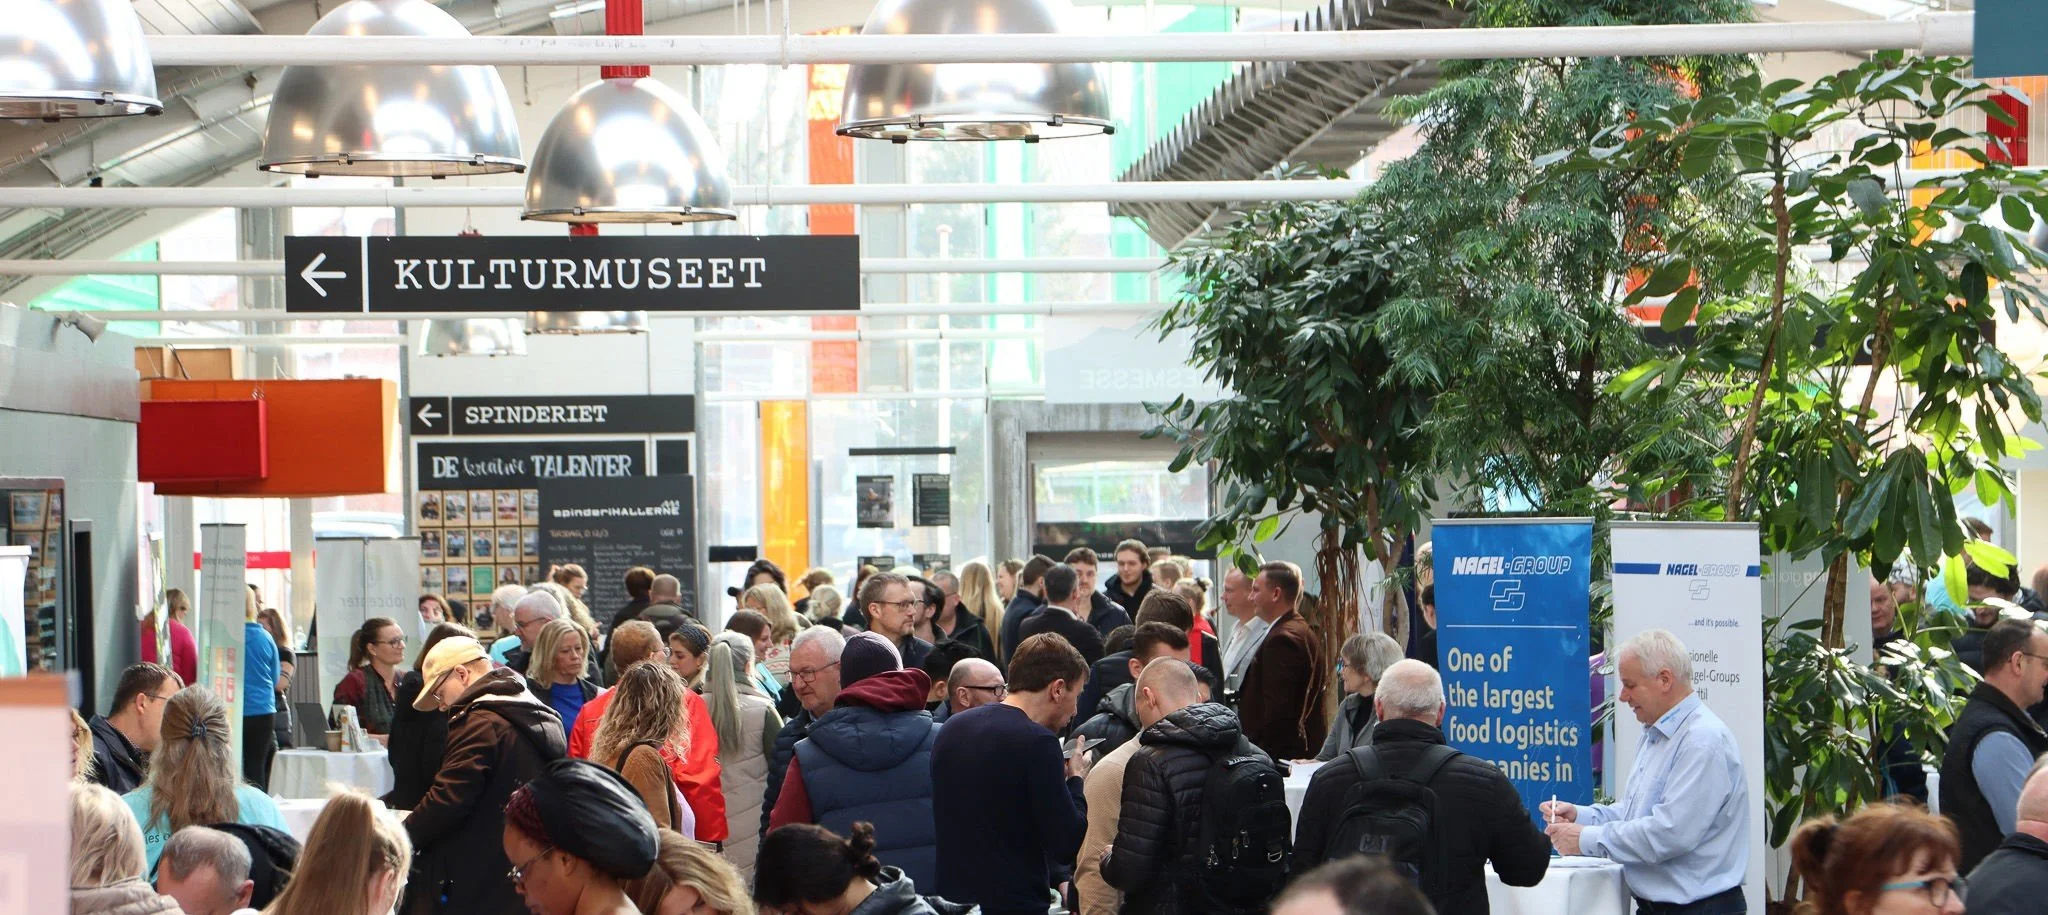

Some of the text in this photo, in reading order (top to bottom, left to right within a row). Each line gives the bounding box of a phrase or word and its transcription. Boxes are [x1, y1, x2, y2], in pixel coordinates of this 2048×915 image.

[394, 257, 767, 290] KULTURMUSEET
[465, 405, 608, 424] SPINDERIET
[432, 454, 633, 478] DE kreative TALENTER
[552, 504, 680, 518] spinderiHALLERNE
[1448, 645, 1513, 673] One of
[1449, 680, 1555, 714] the largest
[1450, 715, 1578, 750] food logistics
[1486, 754, 1573, 783] anies in
